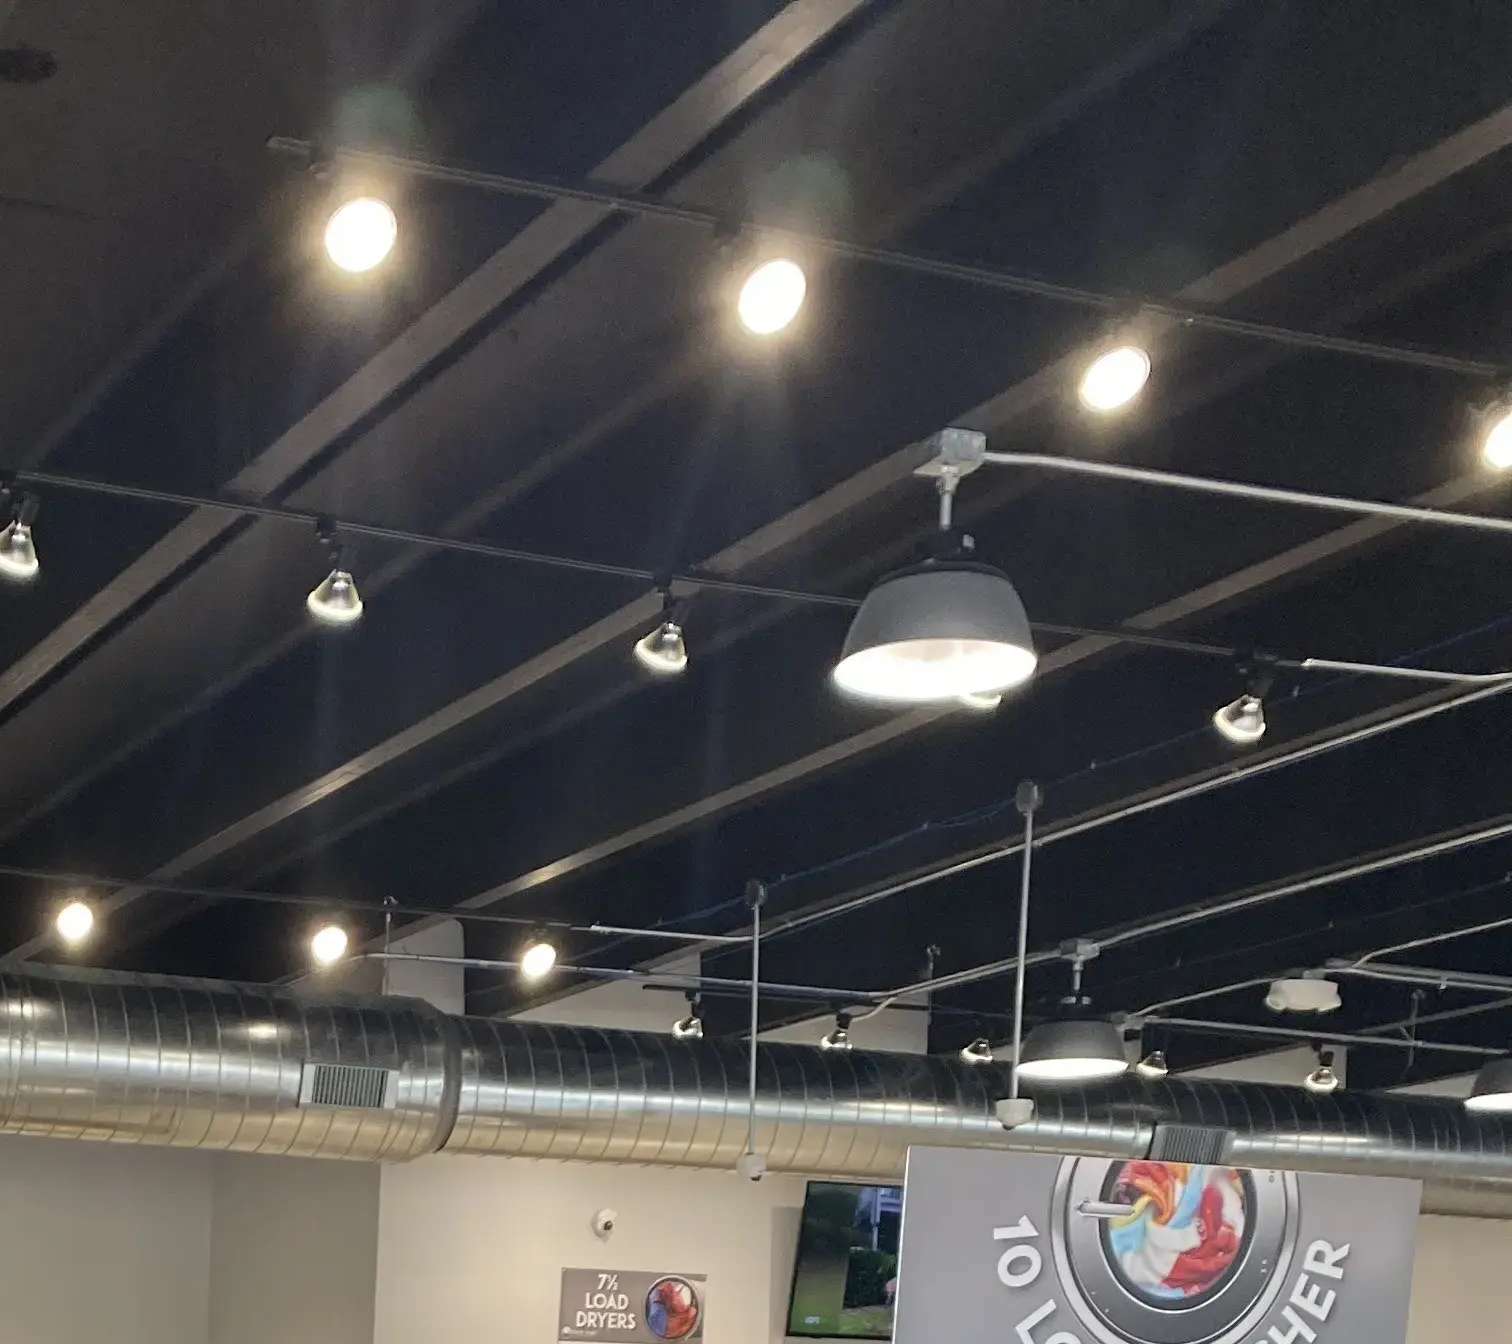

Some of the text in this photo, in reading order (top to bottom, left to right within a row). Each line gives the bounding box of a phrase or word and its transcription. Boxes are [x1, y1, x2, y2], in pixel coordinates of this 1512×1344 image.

[992, 1213, 1043, 1288] 10
[585, 1292, 629, 1310] LOAD
[575, 1310, 637, 1330] DRYERS
